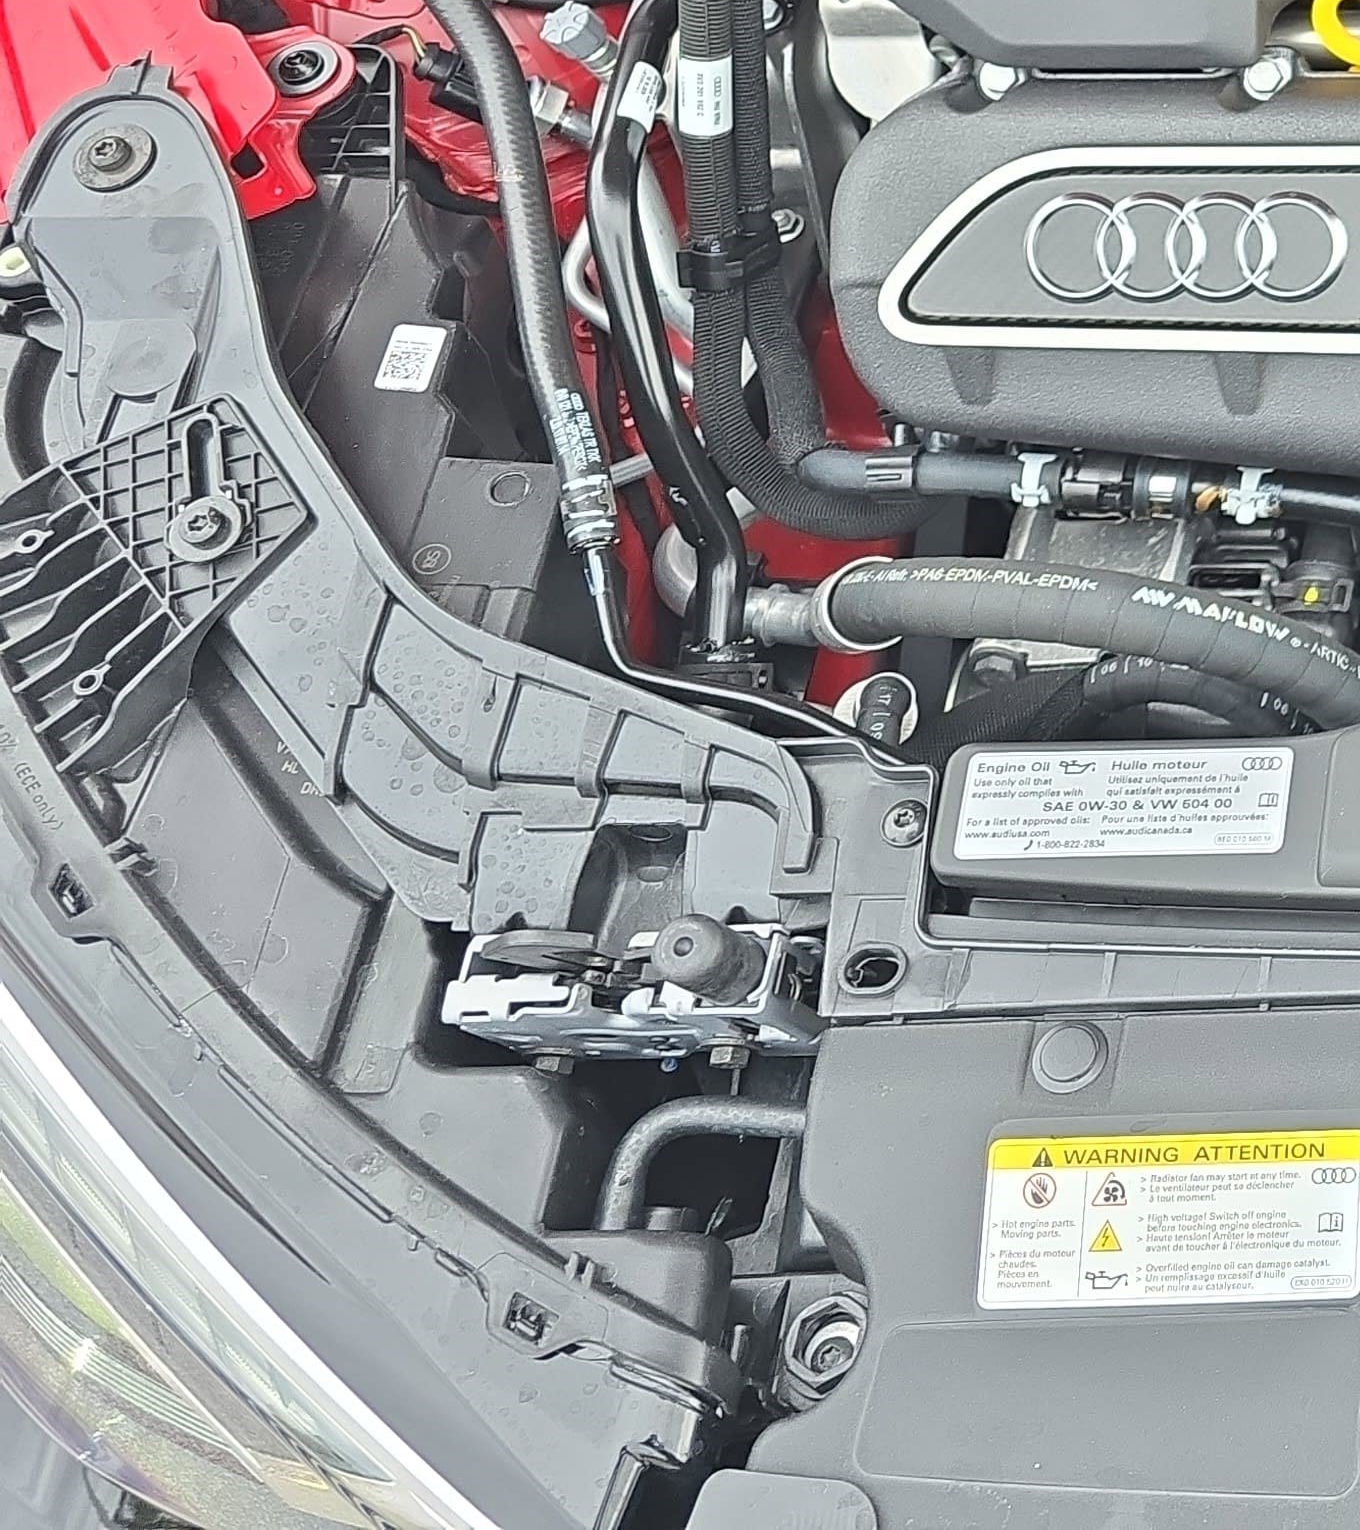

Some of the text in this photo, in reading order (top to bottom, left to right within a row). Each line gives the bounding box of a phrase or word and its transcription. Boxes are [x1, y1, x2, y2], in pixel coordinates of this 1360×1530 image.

[977, 761, 1051, 774] Engine Oil
[1111, 760, 1208, 771] Huile moteur
[973, 777, 1052, 788] Use only oil that
[1108, 775, 1143, 785] Utilisez
[1145, 774, 1203, 784] uniquement
[1204, 774, 1217, 783] de
[13, 762, 65, 831] (ECE only)
[971, 787, 1084, 800] expressly complies with
[1106, 787, 1122, 797] qui
[1124, 786, 1162, 796] satisfait
[1164, 785, 1233, 796] expressément
[1042, 798, 1233, 812] SAE 0W-30 & VW 504 00
[966, 818, 982, 827] For
[992, 817, 1007, 826] list
[1010, 816, 1020, 826] of
[1022, 816, 1068, 828] approved
[1101, 814, 1124, 824] Pour
[1126, 815, 1145, 823] une
[1147, 813, 1167, 823] liste
[964, 829, 1050, 840] www.audiusa.com
[1099, 826, 1193, 837] www.audicanada.ca
[1037, 839, 1105, 849] 1-800-822-2834
[1064, 1143, 1326, 1165] WARNING ATTENTION
[1150, 1174, 1188, 1183] Radiator
[1190, 1173, 1205, 1183] fan
[1206, 1175, 1226, 1183] may
[1228, 1172, 1248, 1182] start
[1260, 1173, 1277, 1182] any
[1149, 1184, 1161, 1193] Le
[1162, 1183, 1210, 1193] ventilateur
[1211, 1183, 1231, 1193] peut
[1246, 1181, 1294, 1191] déclencher
[1156, 1194, 1175, 1202] tout
[1148, 1213, 1169, 1224] High
[1209, 1211, 1240, 1221] Switch
[1241, 1210, 1255, 1220] off
[1256, 1211, 1287, 1221] engine
[1002, 1219, 1018, 1229] Hot
[1019, 1219, 1050, 1231] engine
[1147, 1222, 1176, 1233] before
[1178, 1221, 1217, 1232] touching
[1219, 1221, 1250, 1232] engine
[1001, 1229, 1033, 1240] Moving
[1146, 1233, 1172, 1243] Haute
[1246, 1230, 1254, 1239] le
[1256, 1230, 1289, 1240] moteur
[1145, 1243, 1170, 1253] avant
[1172, 1243, 1184, 1252] de
[1185, 1241, 1221, 1251] toucher
[1293, 1239, 1305, 1248] du
[1029, 1249, 1041, 1259] du
[1043, 1249, 1076, 1258] moteur
[1145, 1262, 1189, 1273] Overfilled
[1191, 1262, 1222, 1273] engine
[1223, 1261, 1235, 1271] oil
[1237, 1261, 1253, 1270] can
[1255, 1260, 1292, 1271] damage
[1145, 1274, 1159, 1283] Un
[1160, 1273, 1215, 1285] remplissage
[1217, 1271, 1254, 1281] excessif
[1144, 1283, 1165, 1294] peut
[1166, 1282, 1190, 1292] nuire
[1192, 1283, 1204, 1291] au
